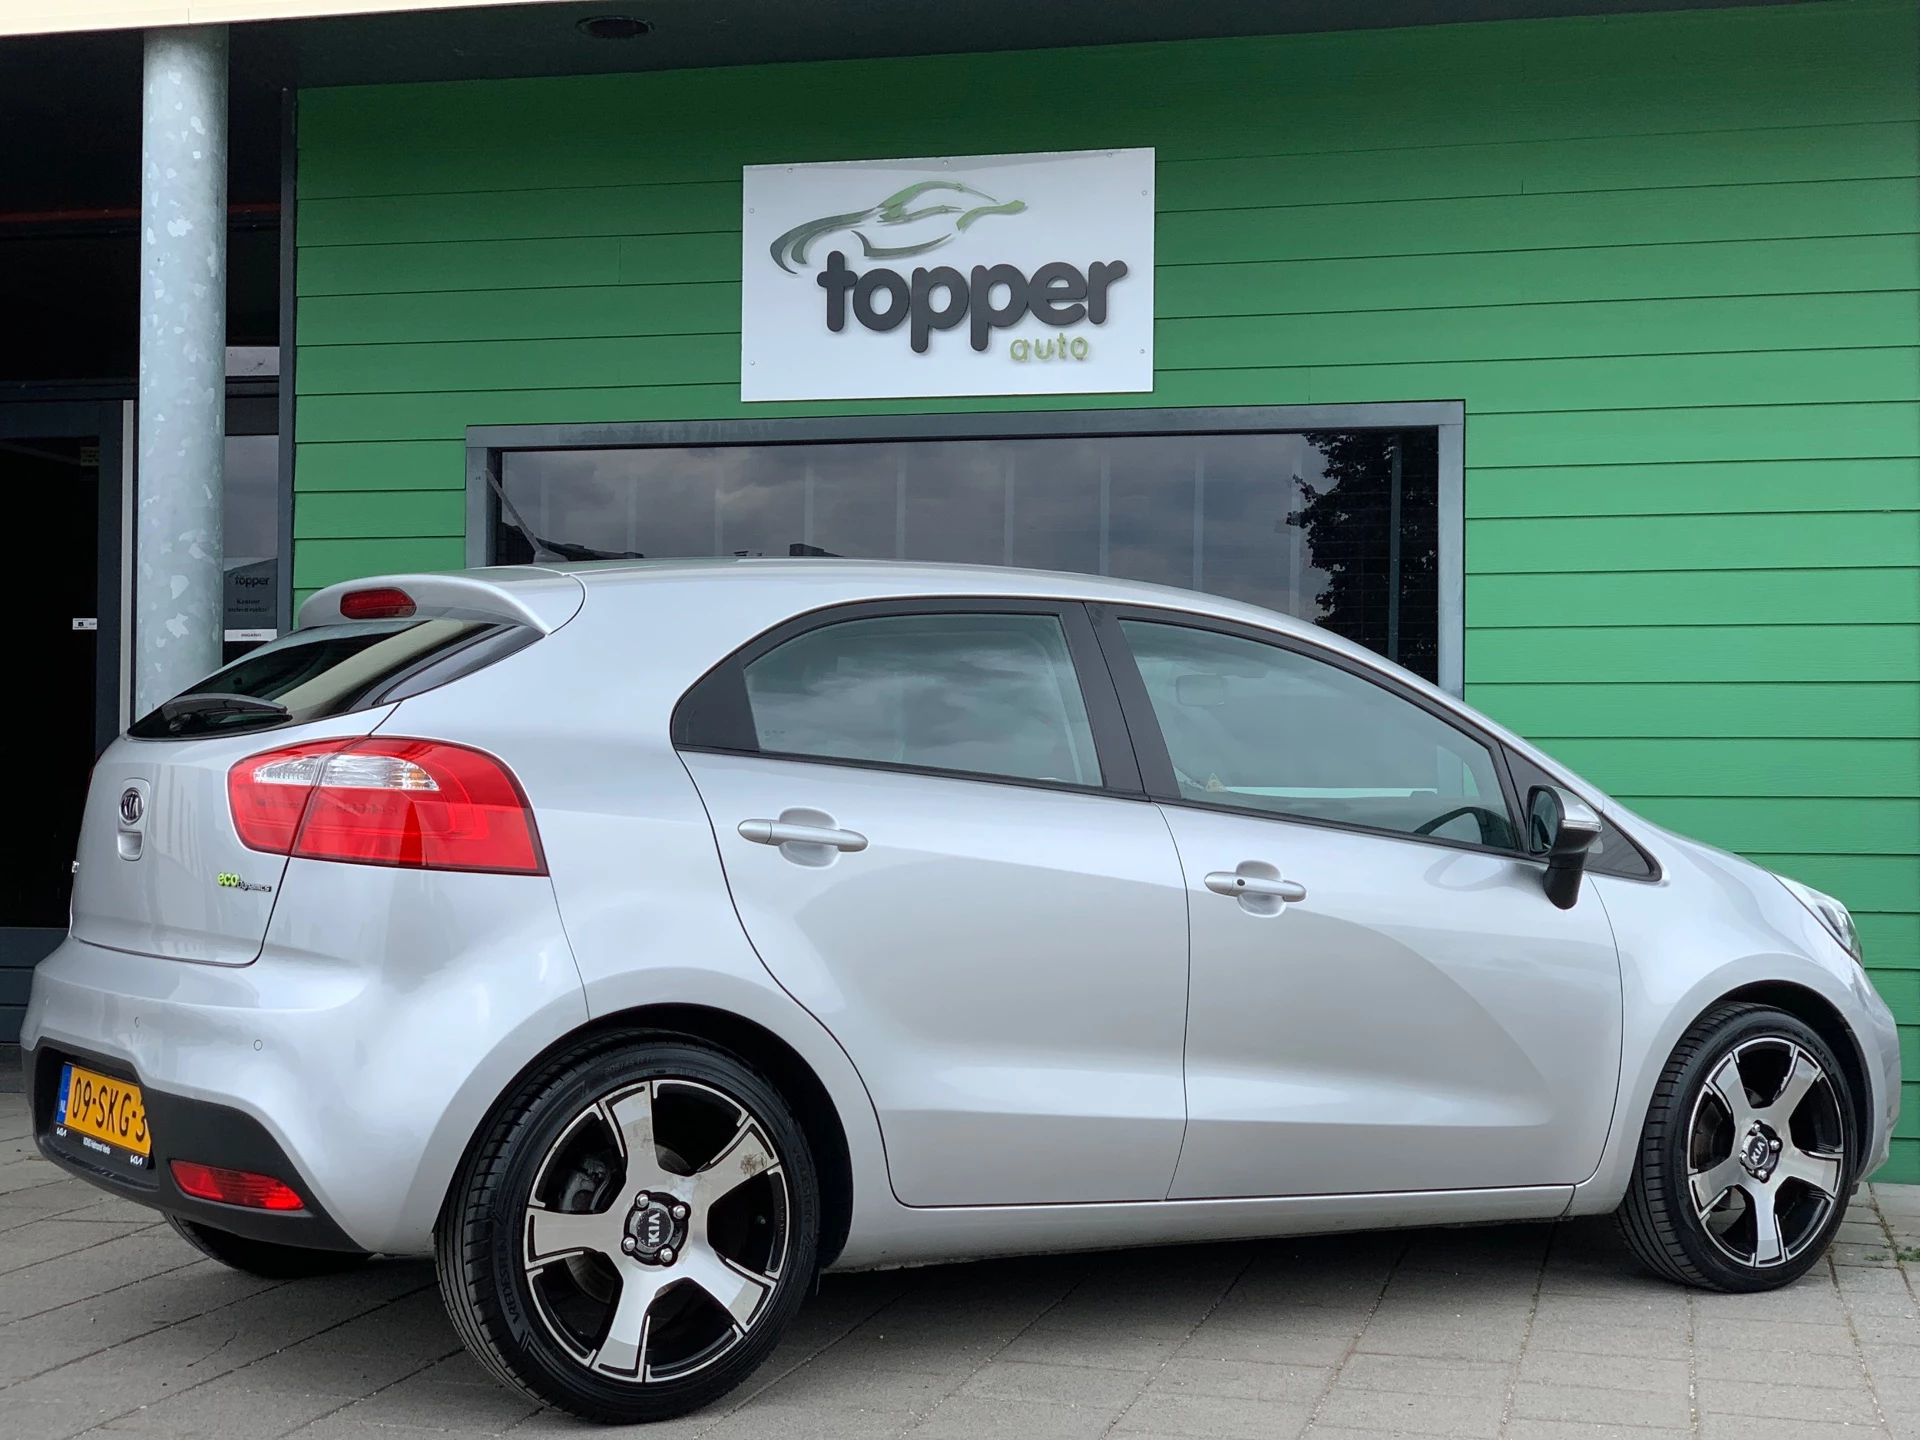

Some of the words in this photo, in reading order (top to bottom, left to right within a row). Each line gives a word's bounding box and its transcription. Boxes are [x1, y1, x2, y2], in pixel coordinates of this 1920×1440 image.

[817, 250, 1128, 353] topper
[1009, 332, 1088, 361] auto
[234, 575, 270, 588] topper
[1751, 1141, 1766, 1165] KIA
[648, 1213, 660, 1243] KIA
